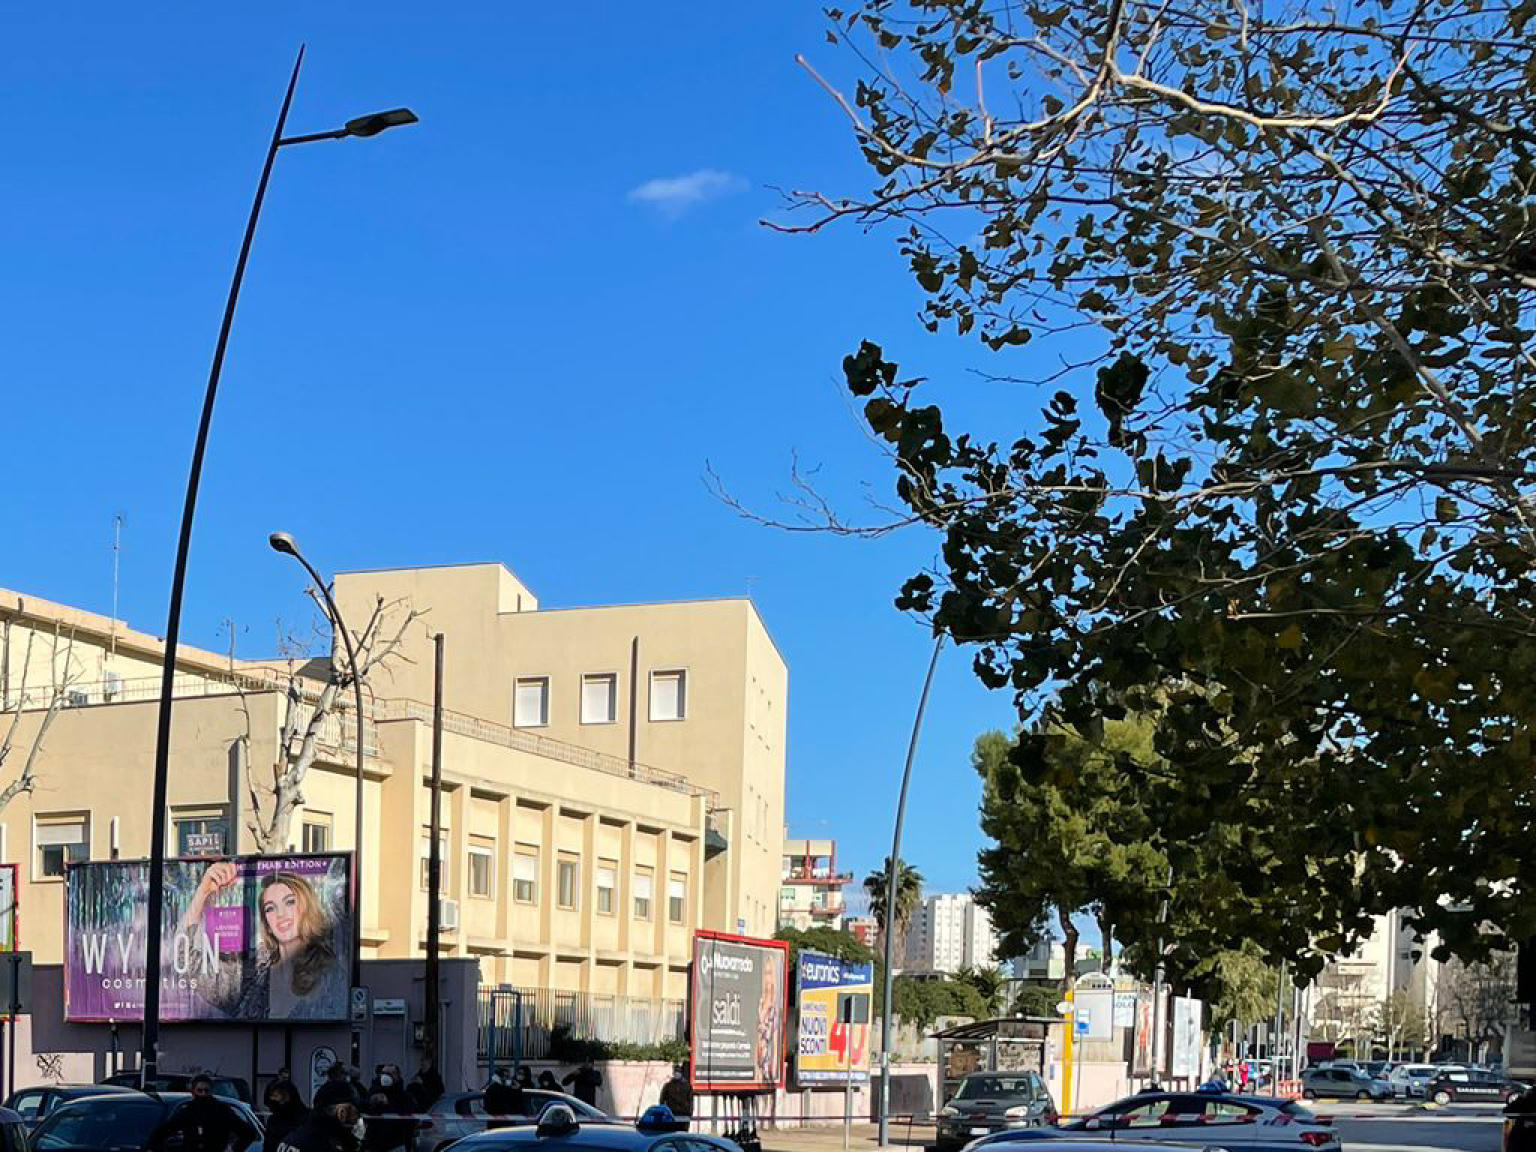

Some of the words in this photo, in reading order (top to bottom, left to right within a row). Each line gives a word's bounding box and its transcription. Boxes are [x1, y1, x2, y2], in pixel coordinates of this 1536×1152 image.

[82, 933, 221, 975] WYON
[102, 977, 198, 989] cosmtics
[806, 959, 841, 984] euronics
[713, 992, 741, 1026] saldi
